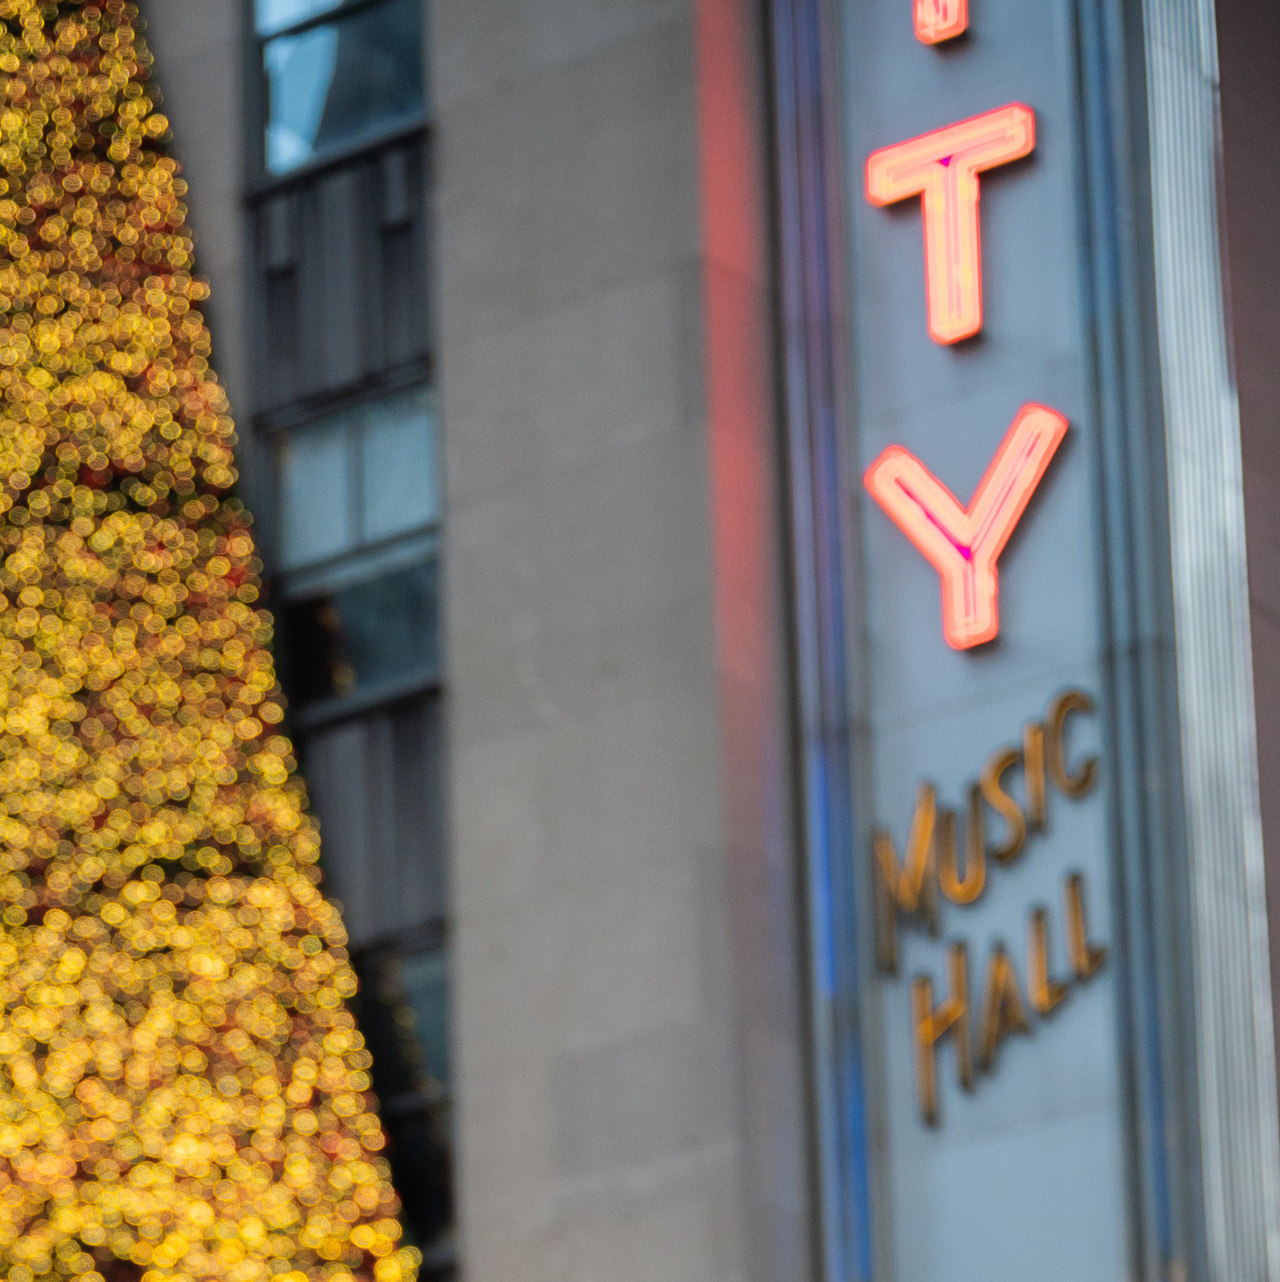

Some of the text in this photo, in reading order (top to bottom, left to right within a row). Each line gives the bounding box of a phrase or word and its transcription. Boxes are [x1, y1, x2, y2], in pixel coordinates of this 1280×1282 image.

[865, 0, 1068, 650] TY
[872, 688, 1100, 977] MUSIC
[910, 868, 1108, 1132] HALL
